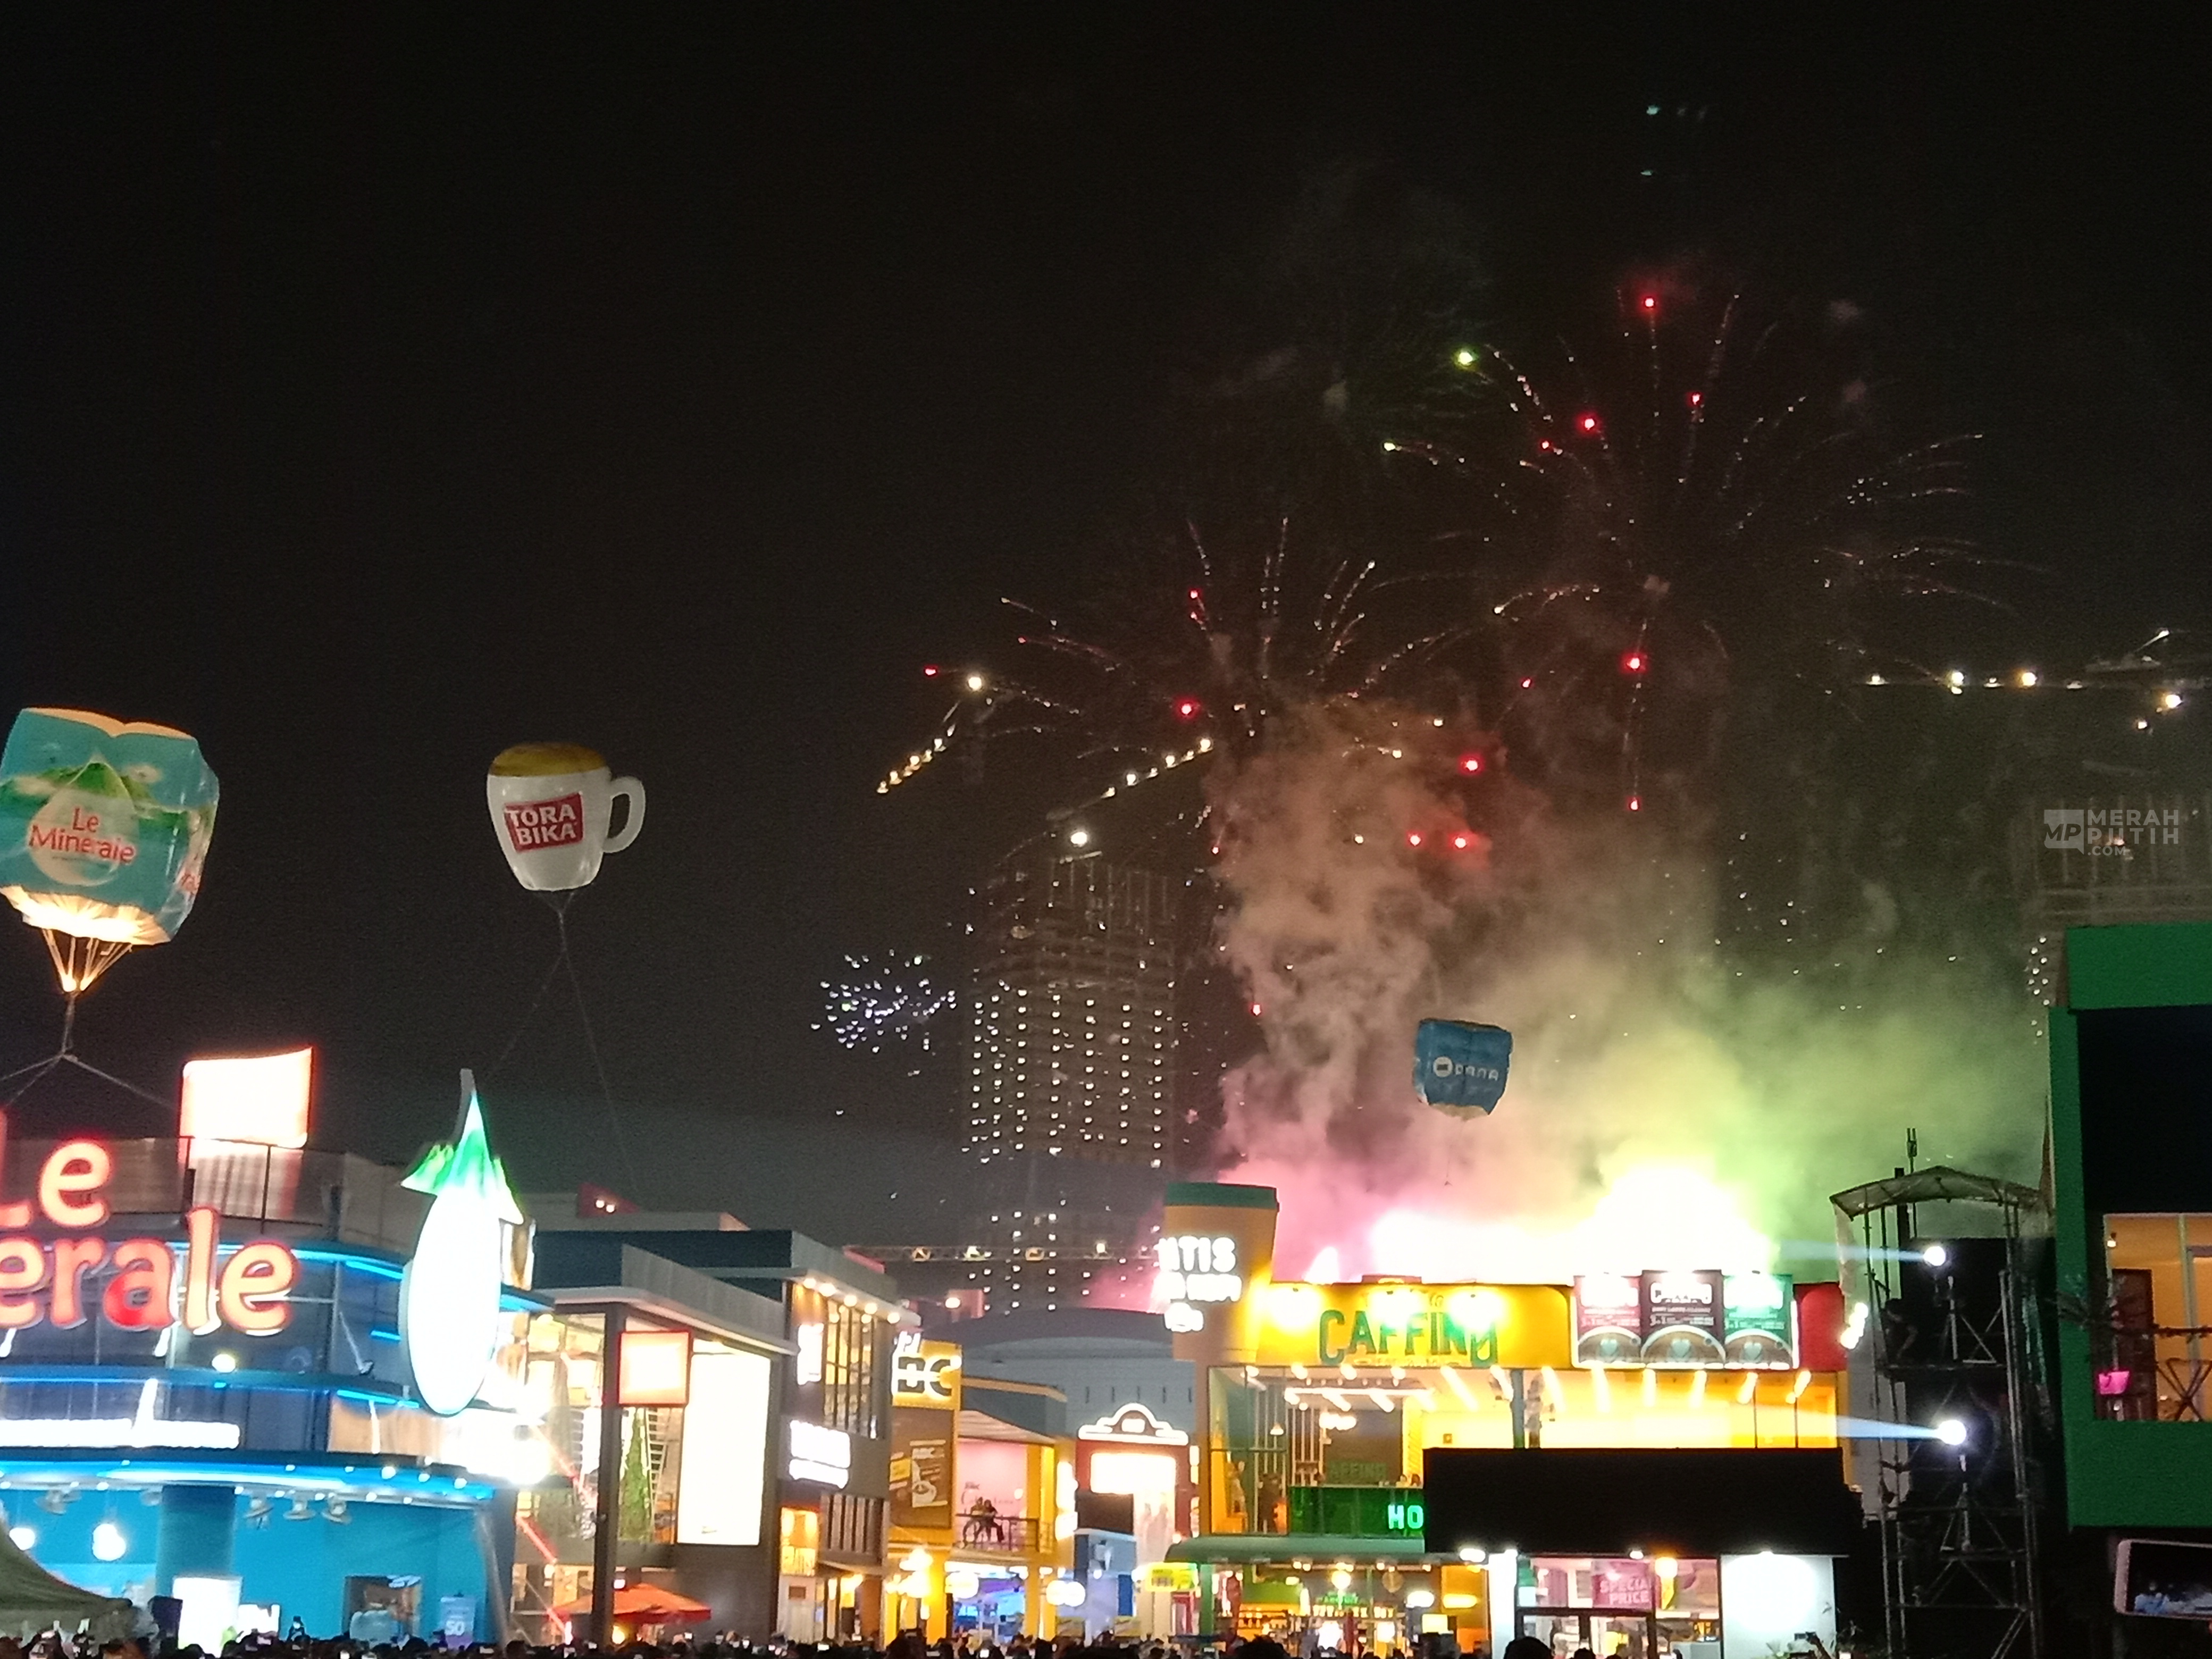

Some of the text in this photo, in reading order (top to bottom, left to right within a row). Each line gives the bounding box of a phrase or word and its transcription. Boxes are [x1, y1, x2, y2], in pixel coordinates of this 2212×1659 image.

[72, 808, 99, 833] Le
[506, 803, 576, 827] TORA
[516, 823, 576, 845] BIKA
